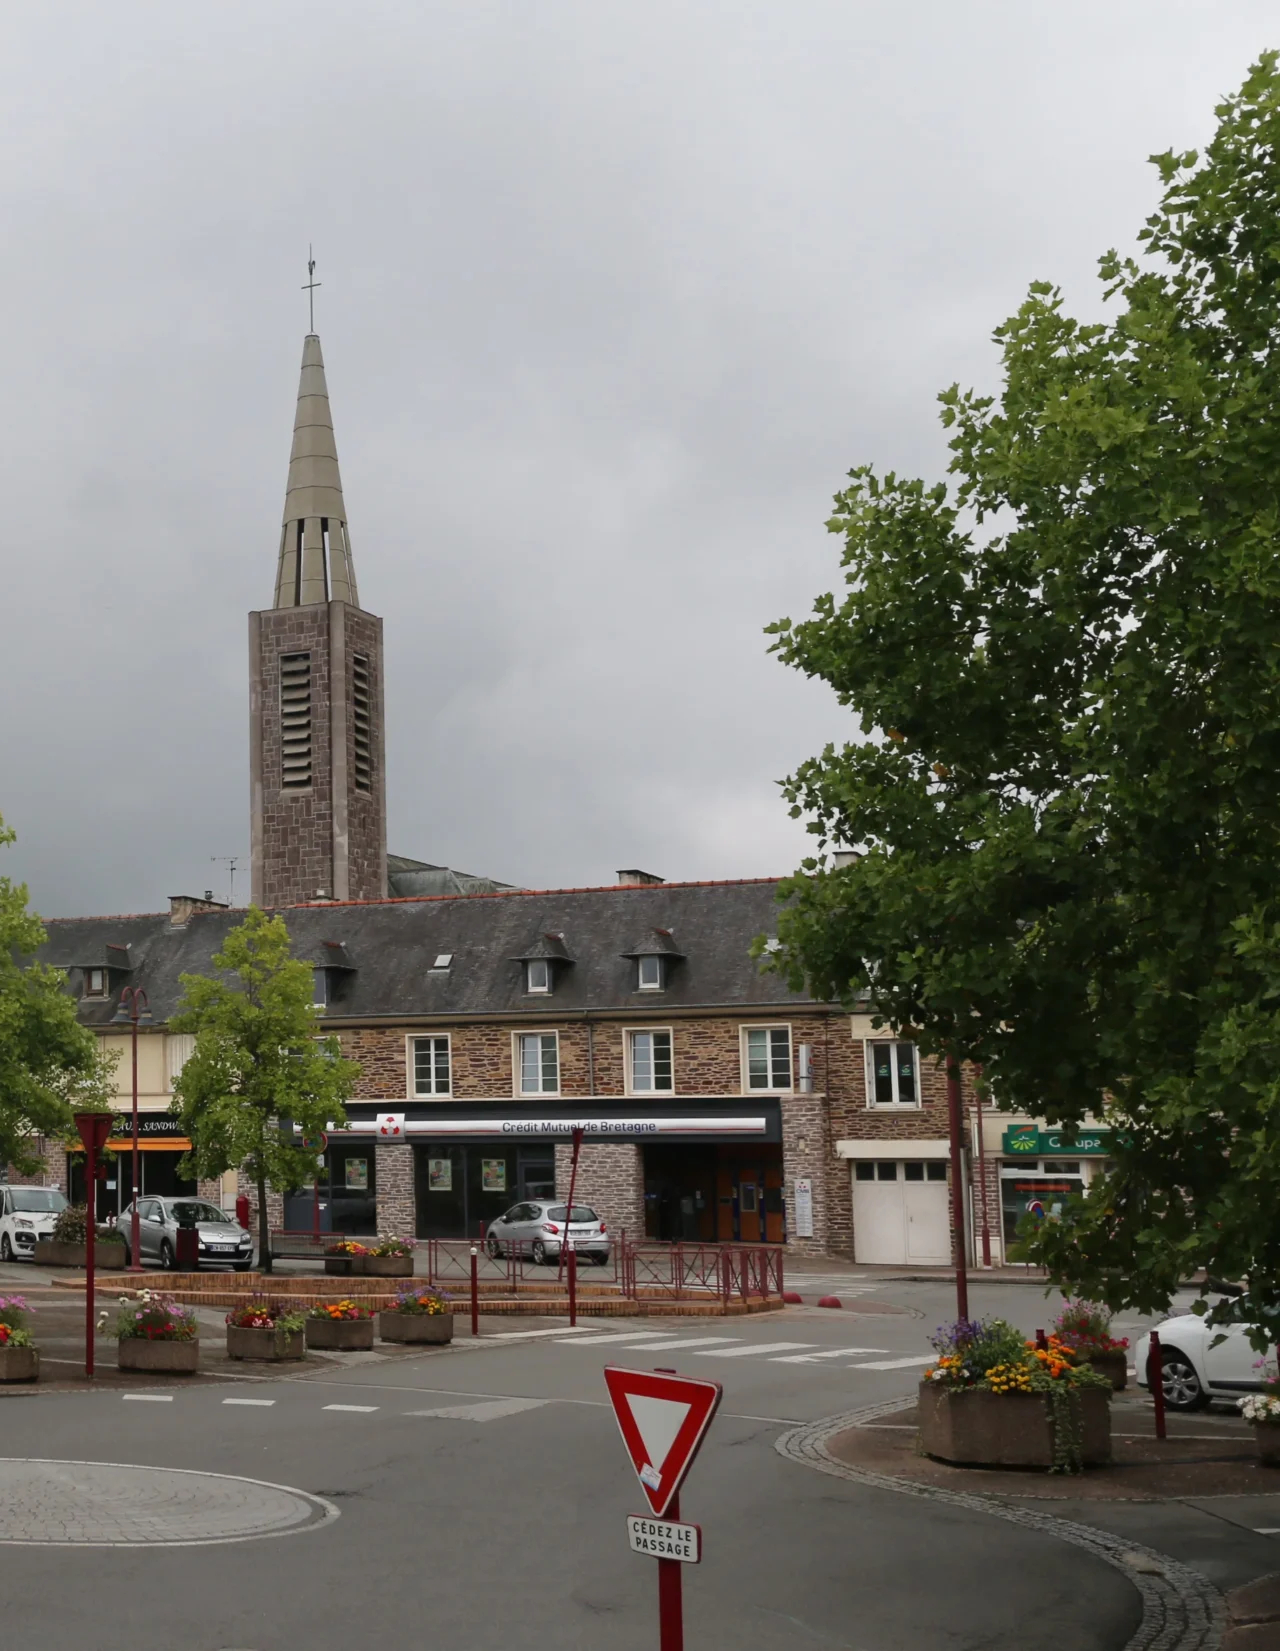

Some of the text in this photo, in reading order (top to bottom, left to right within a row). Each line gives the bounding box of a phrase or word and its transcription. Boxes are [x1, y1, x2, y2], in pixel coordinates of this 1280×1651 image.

[502, 1121, 656, 1133] Crédit Mutuel de Bretagne
[633, 1520, 692, 1542] CÉDEZ LE
[635, 1536, 691, 1557] PASSAGE
